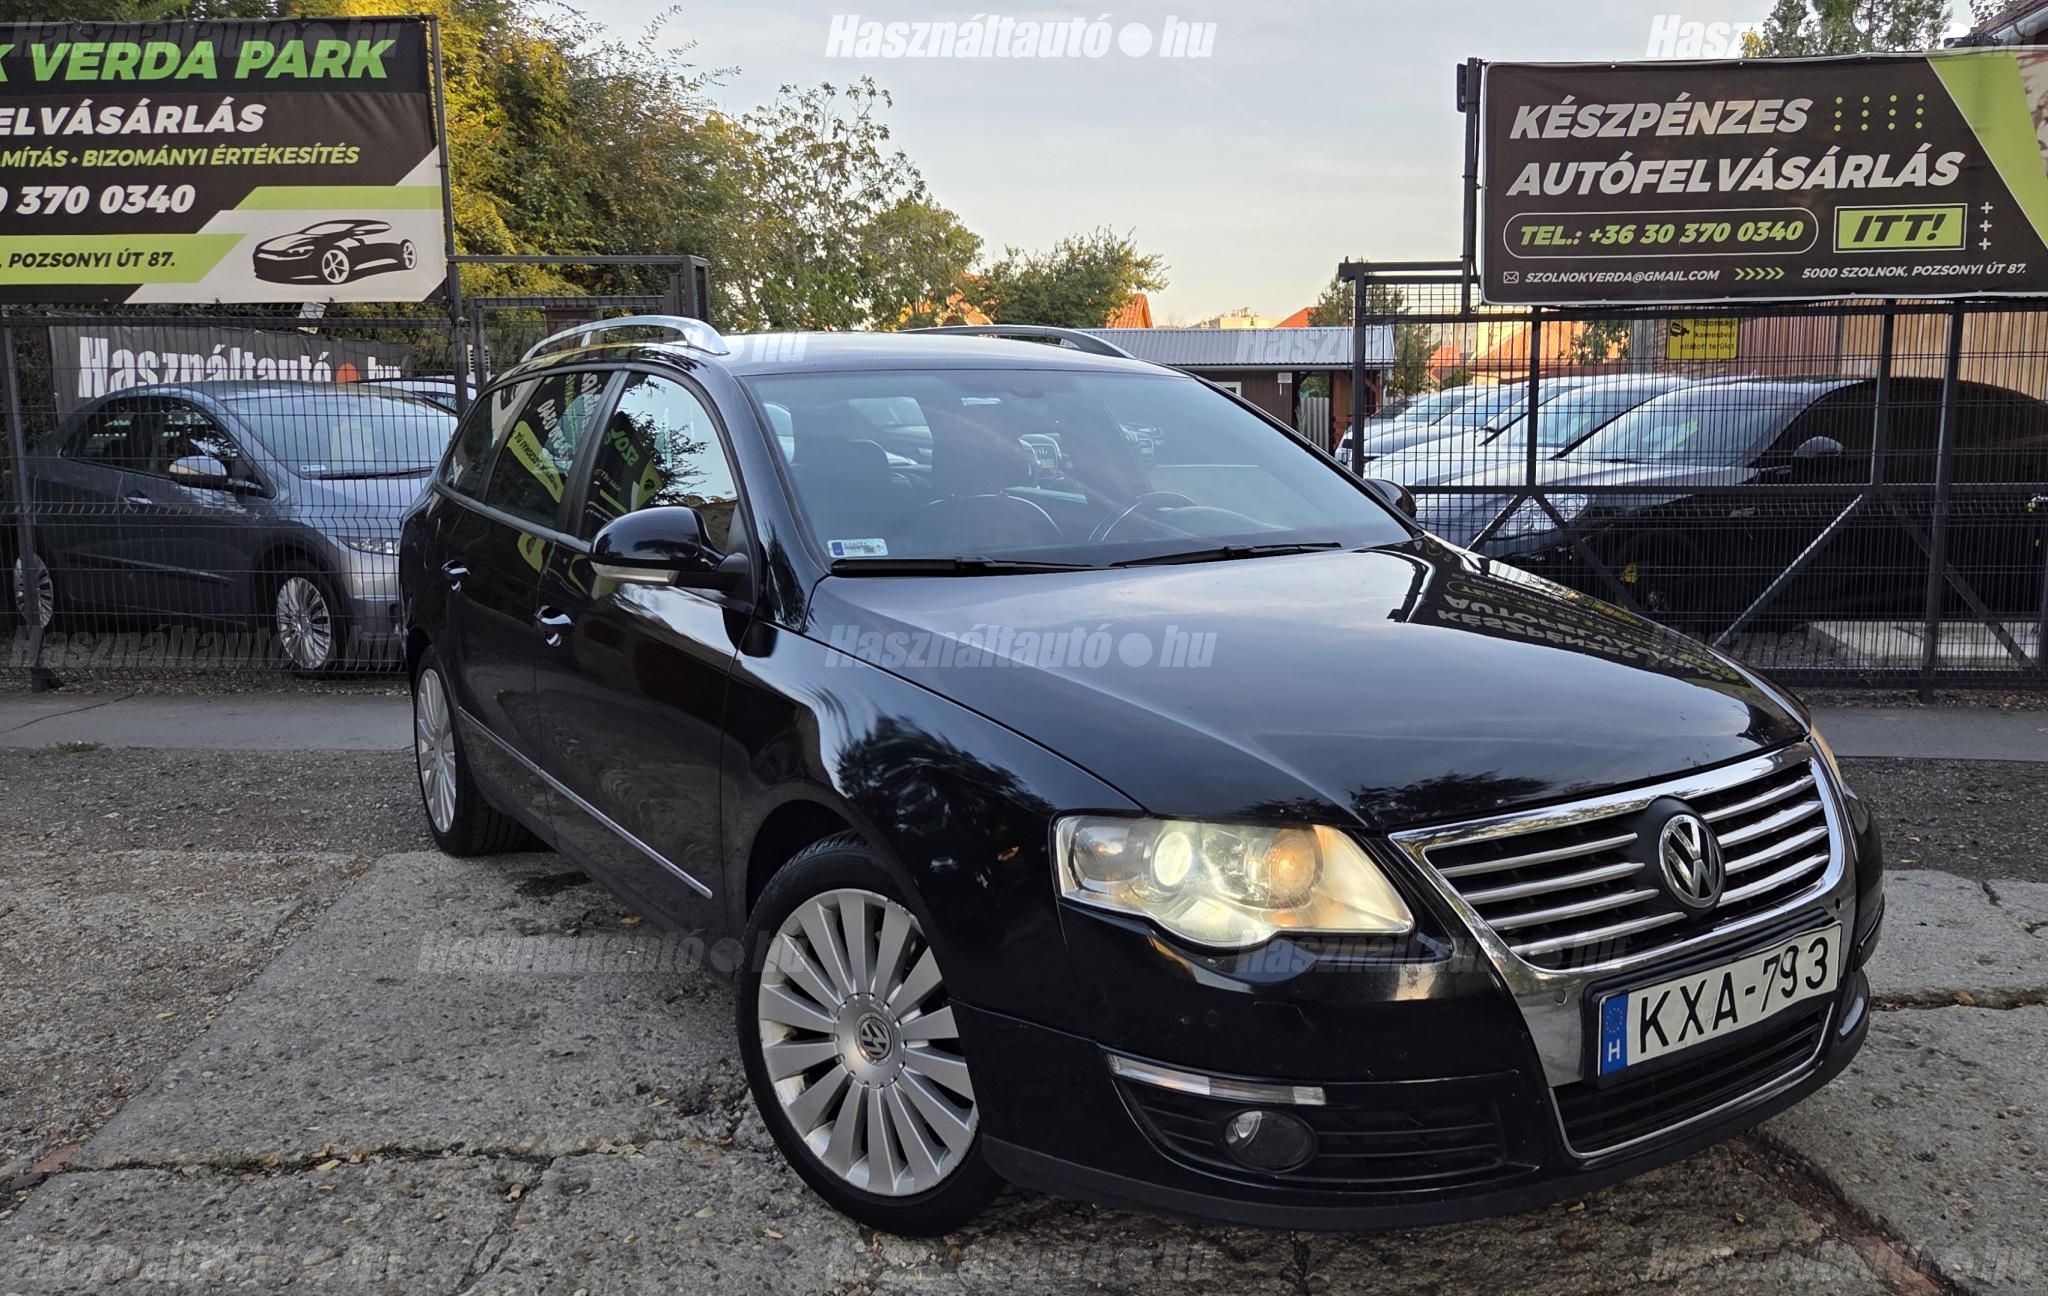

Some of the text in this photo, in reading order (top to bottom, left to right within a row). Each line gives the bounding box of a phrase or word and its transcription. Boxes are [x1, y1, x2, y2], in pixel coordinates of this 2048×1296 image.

[32, 41, 217, 80] VERDA
[235, 41, 395, 78] PARK
[1510, 92, 1813, 139] KÉSZPÉNZES
[82, 145, 208, 167] BIZOMÁNYI
[211, 143, 360, 165] ÉRTÉKESÍTÉS
[1506, 143, 1965, 196] AUTÓFELVÁSÁRLÁS
[16, 186, 89, 214] 370
[100, 185, 195, 213] 0340
[1521, 221, 1803, 245] TEL.: +36 30 370 0340
[1853, 214, 1947, 242] ITT!
[8, 248, 176, 268] POZSONYI ÚT 87.
[1802, 261, 2027, 278] 5000 SZOLNOK, POZSONYI ÚT 87.
[1525, 269, 1720, 284] SZOLNOKVERDA@GMAIL.COM
[1640, 936, 1829, 1054] KXA-793
[1608, 1039, 1621, 1063] H
